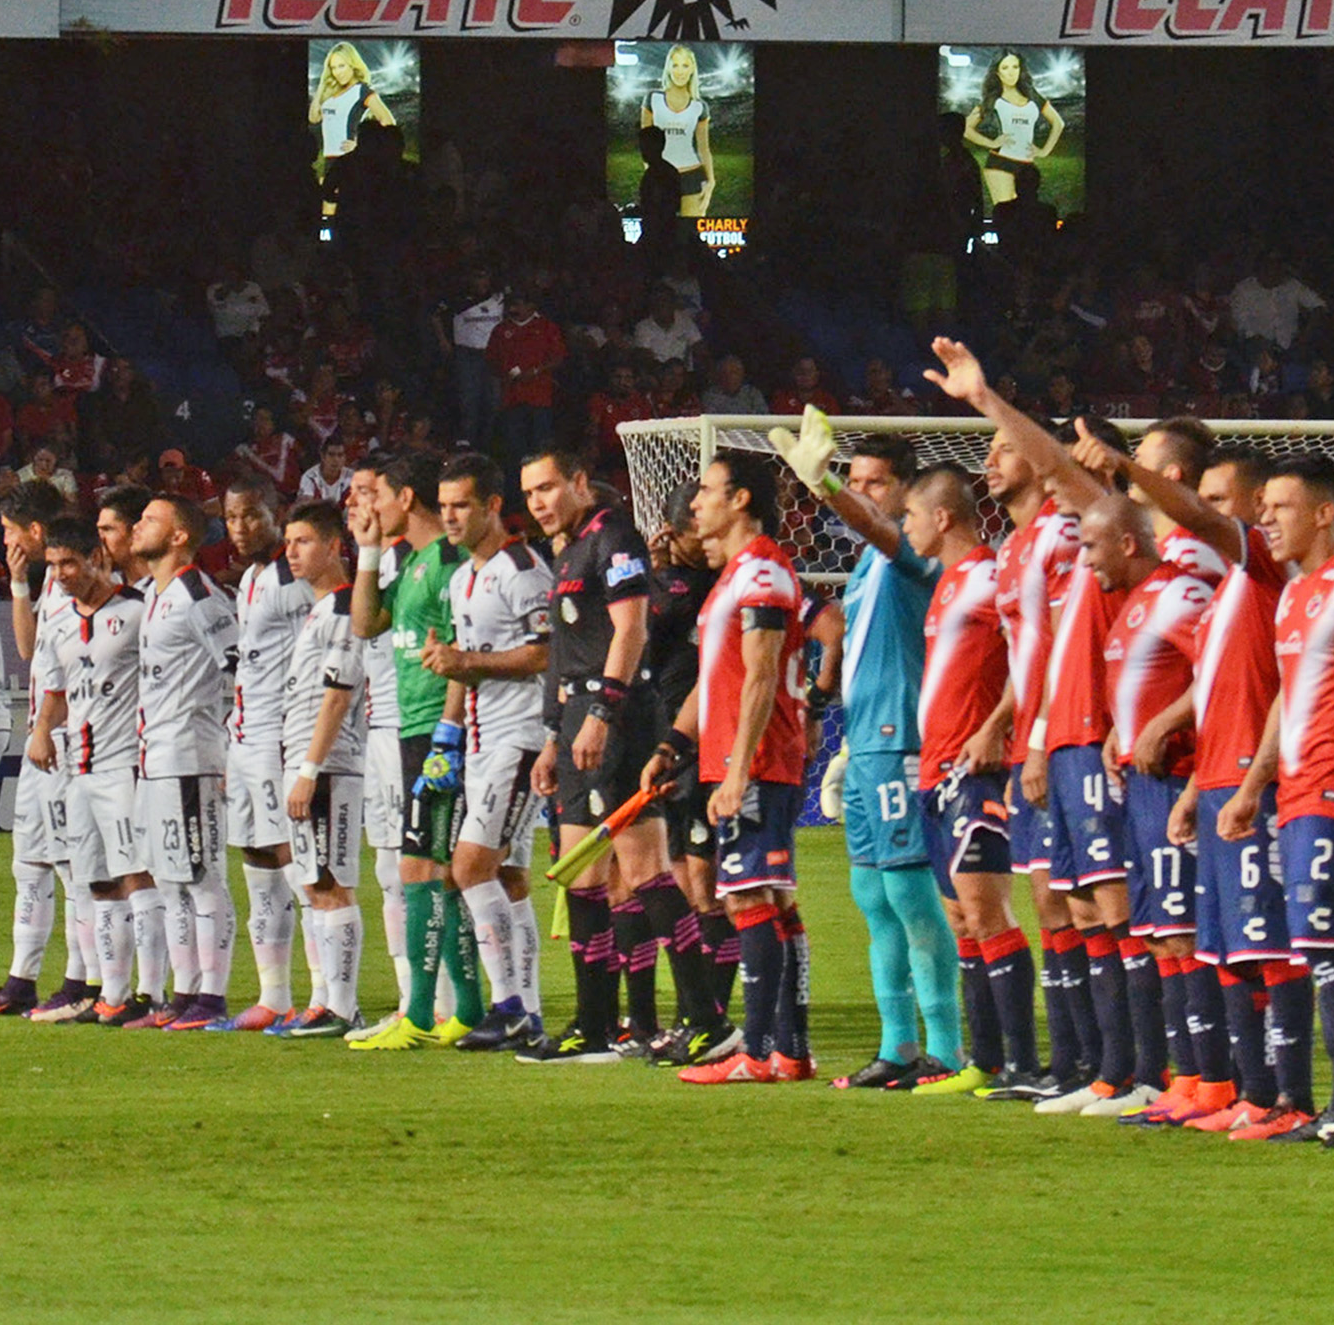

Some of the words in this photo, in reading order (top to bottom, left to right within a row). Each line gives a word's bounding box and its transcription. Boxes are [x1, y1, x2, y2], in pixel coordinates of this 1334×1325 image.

[696, 218, 749, 233] CHARLY
[175, 400, 191, 420] 4
[481, 782, 497, 814] 4
[876, 780, 908, 822] 13
[1083, 772, 1104, 812] 4
[208, 799, 219, 863] PERDURA
[336, 802, 350, 867] PERDURA
[1150, 845, 1182, 889] 17
[1240, 844, 1261, 889] 6
[1310, 837, 1334, 881] 2
